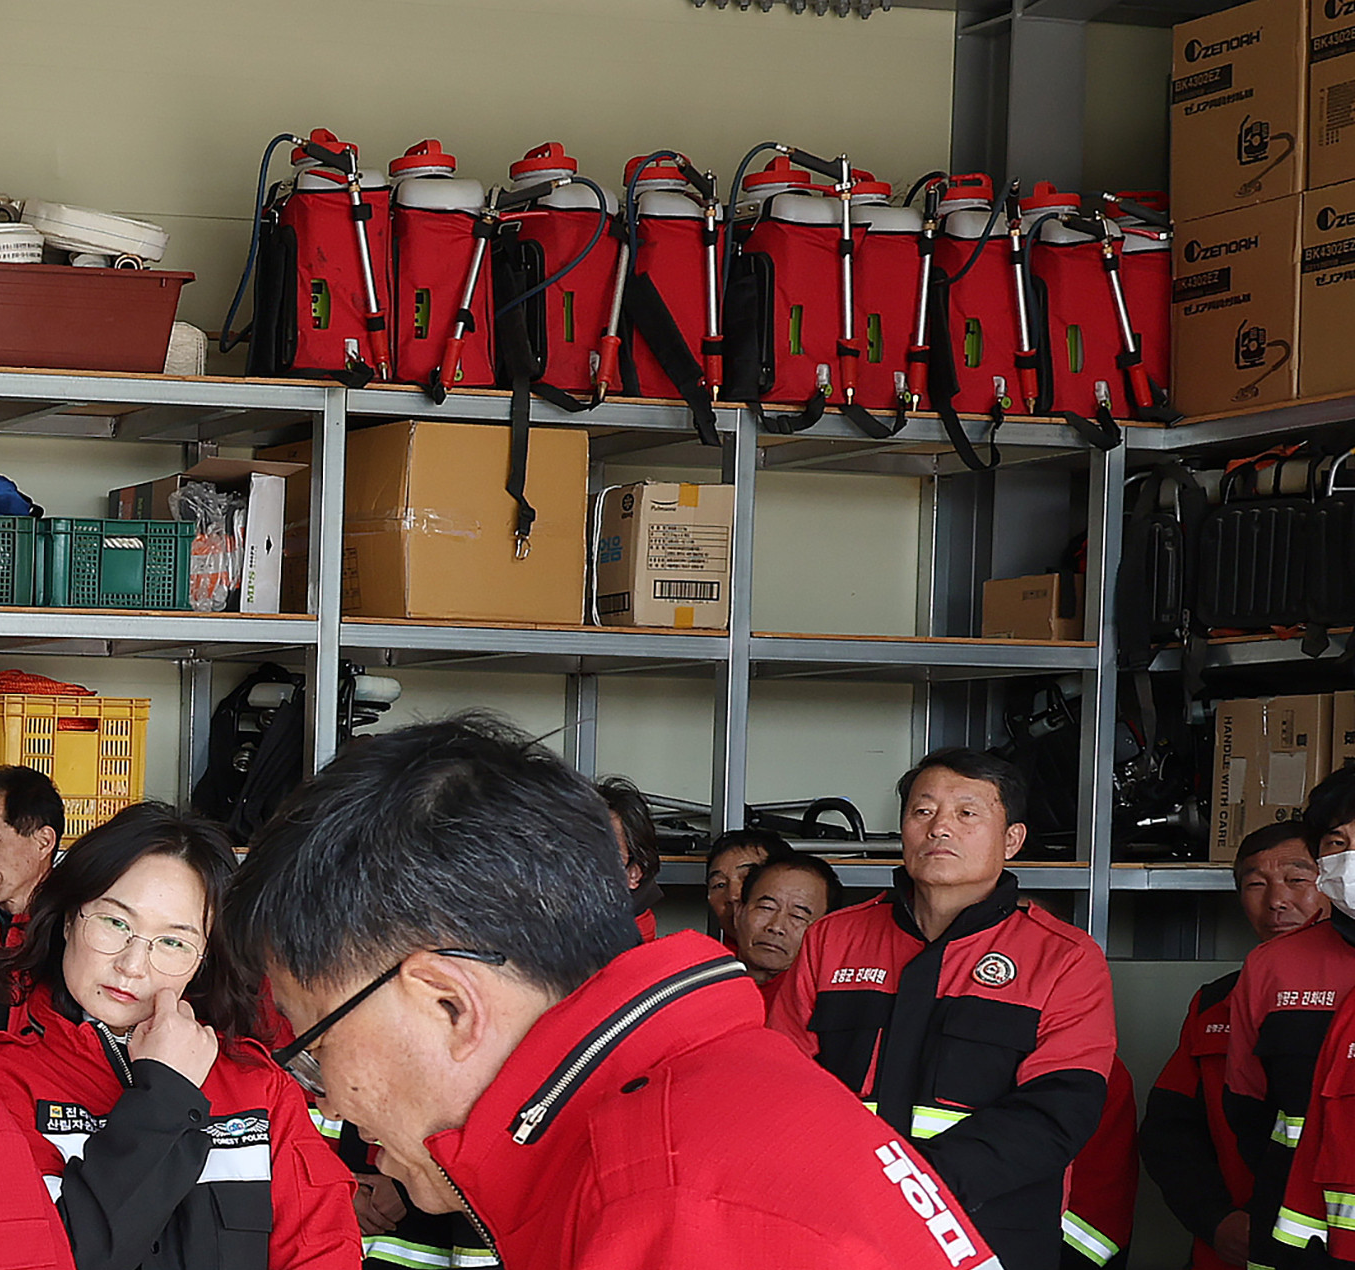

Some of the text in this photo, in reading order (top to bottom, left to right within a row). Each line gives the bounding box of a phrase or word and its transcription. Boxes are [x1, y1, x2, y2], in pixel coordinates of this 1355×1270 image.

[1201, 31, 1260, 58] ZENOAH
[1201, 236, 1259, 260] ZENOAH
[1218, 716, 1232, 847] HANDLE WITH CARE
[212, 1133, 269, 1146] FOREST POLICE
